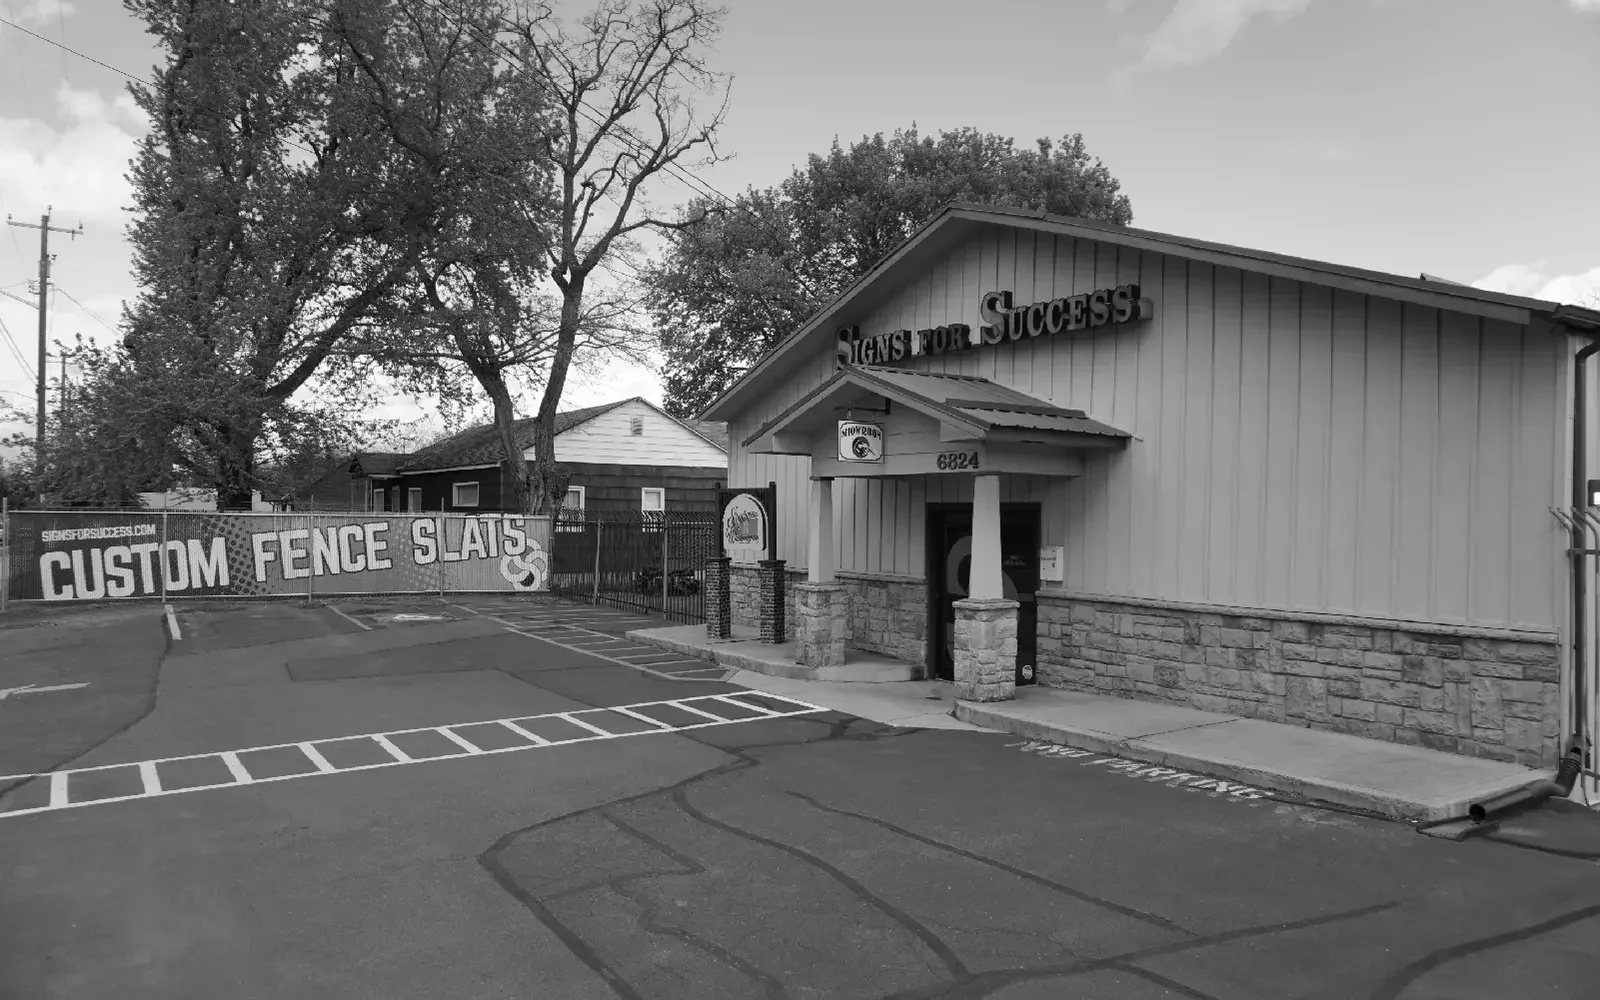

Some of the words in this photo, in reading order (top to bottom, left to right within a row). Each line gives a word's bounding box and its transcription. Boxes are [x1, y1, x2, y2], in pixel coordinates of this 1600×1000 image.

[917, 324, 971, 356] FOR
[980, 285, 1138, 345] SUCCESS
[936, 451, 979, 470] 6824
[42, 524, 156, 542] SIGNSFORSUCCESS.COM
[39, 537, 230, 600] CUSTOM
[251, 521, 393, 582] FENCE
[411, 514, 526, 565] SLATS
